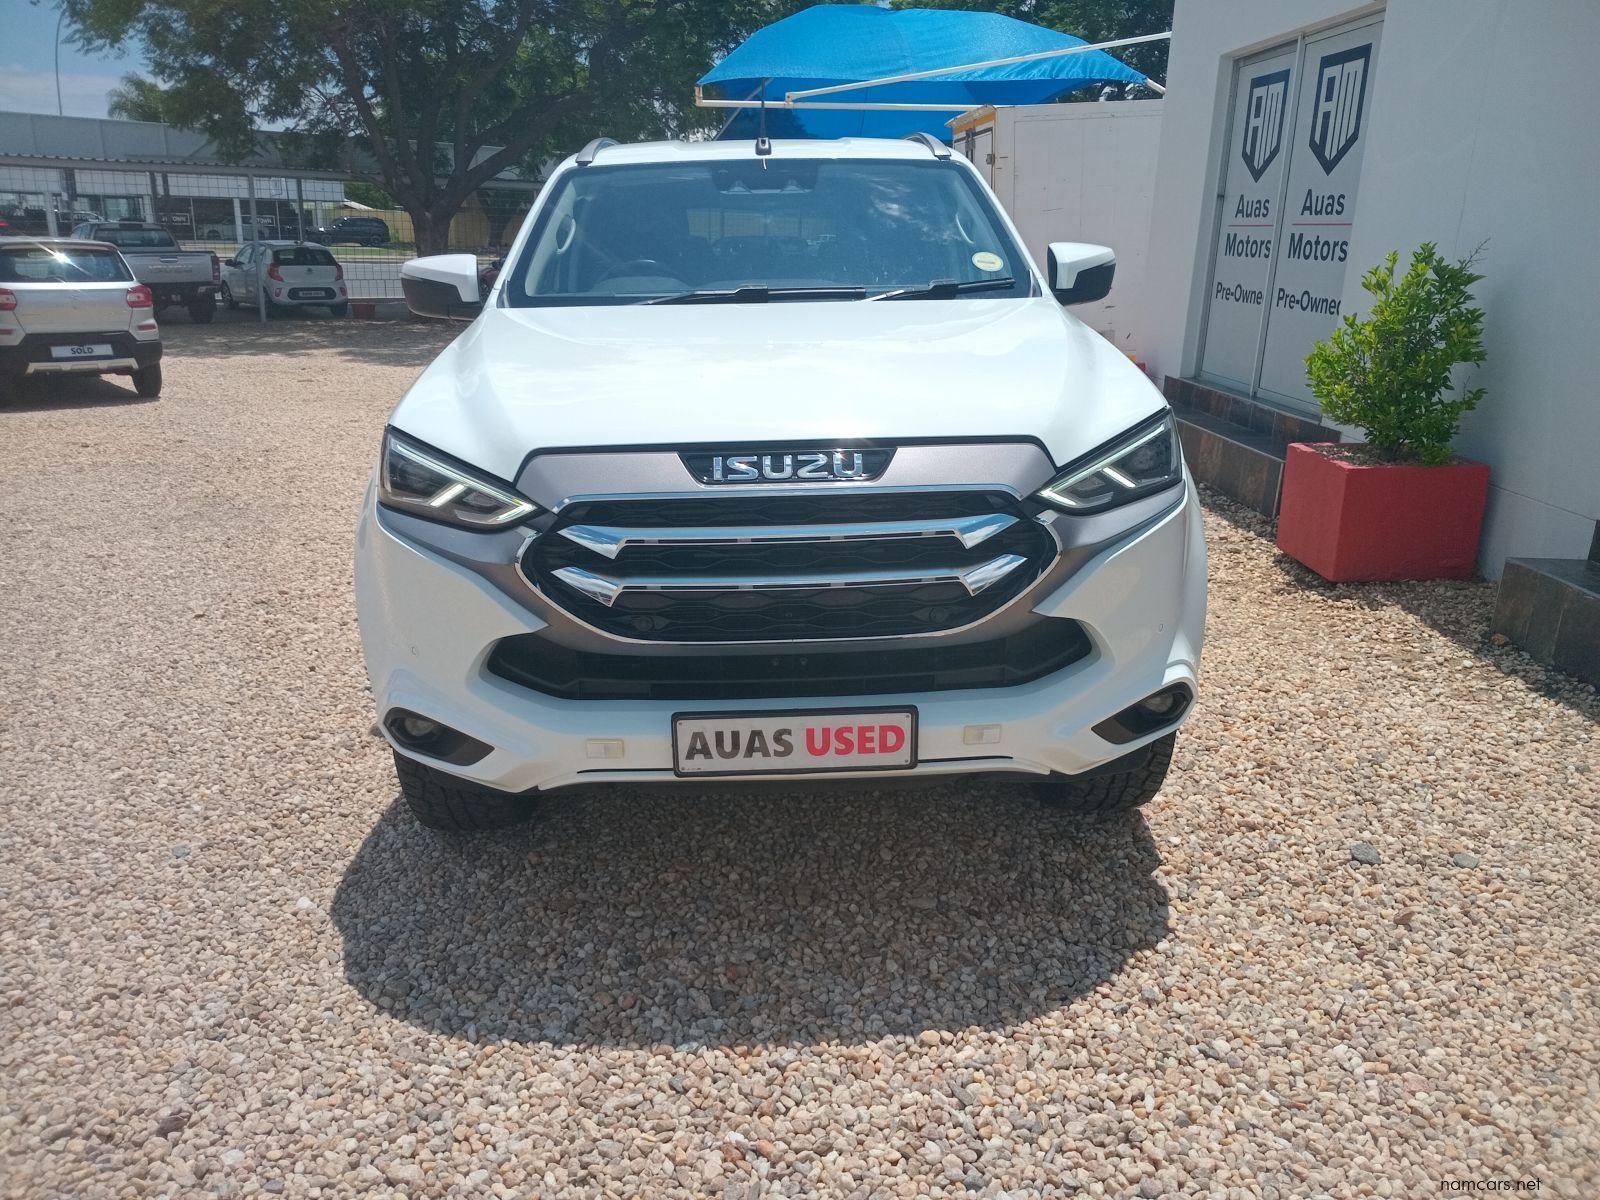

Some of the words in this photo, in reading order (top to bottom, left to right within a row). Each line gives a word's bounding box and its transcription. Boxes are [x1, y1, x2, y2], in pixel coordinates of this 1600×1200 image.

[1235, 194, 1270, 218] Auas
[1301, 189, 1346, 216] Auas
[1225, 233, 1272, 259] Motors
[1288, 233, 1349, 262] Motors
[1215, 282, 1263, 305] Pre-Owne
[71, 344, 94, 355] SOLD
[713, 452, 863, 481] ISUZU
[685, 728, 794, 761] AUAS
[805, 725, 905, 757] USED
